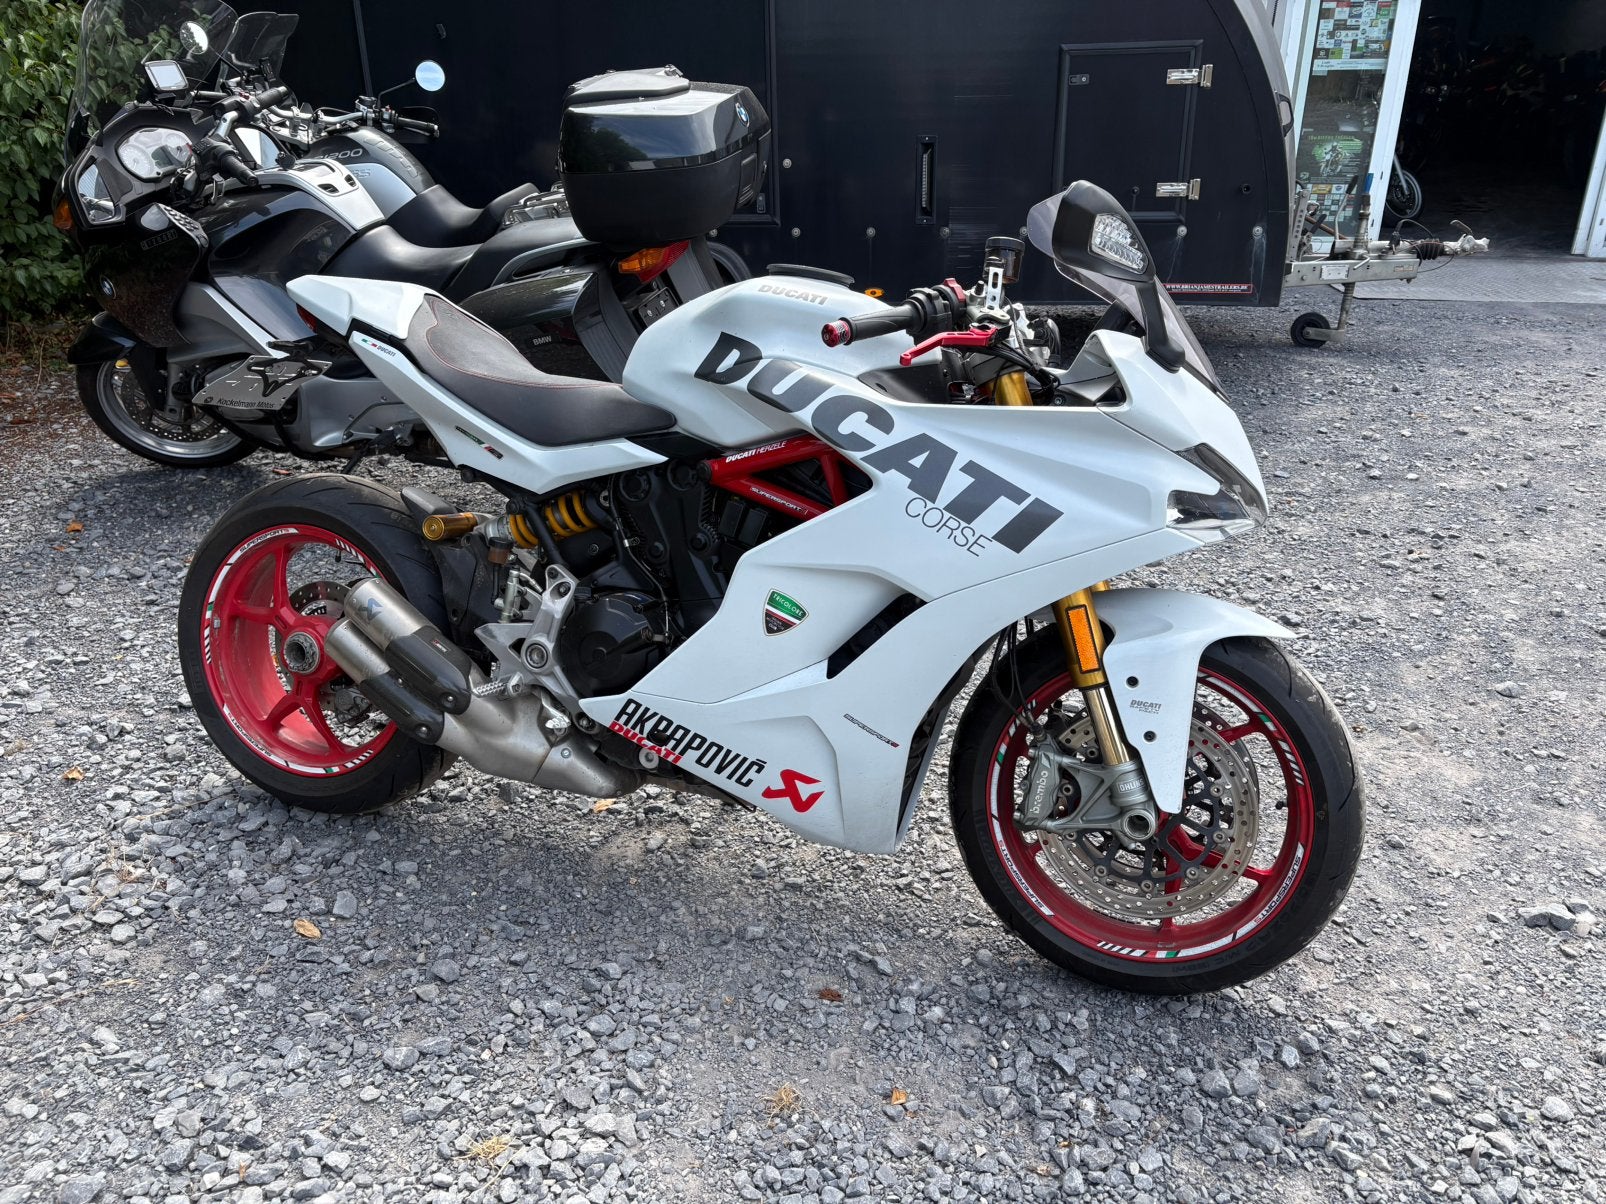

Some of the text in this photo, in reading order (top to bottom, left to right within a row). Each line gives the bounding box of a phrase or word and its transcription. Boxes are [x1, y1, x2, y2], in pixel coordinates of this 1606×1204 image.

[758, 284, 829, 306] DUCATI
[376, 345, 397, 358] DUCATI
[532, 335, 552, 346] BMW
[694, 331, 1065, 555] DUCATI
[725, 449, 756, 464] DUCATI
[904, 496, 993, 557] CORSE
[772, 593, 804, 617] TRICOLORE
[1130, 699, 1162, 710] DUCATI
[608, 720, 684, 765] DUCATI
[1029, 770, 1049, 814] brembo
